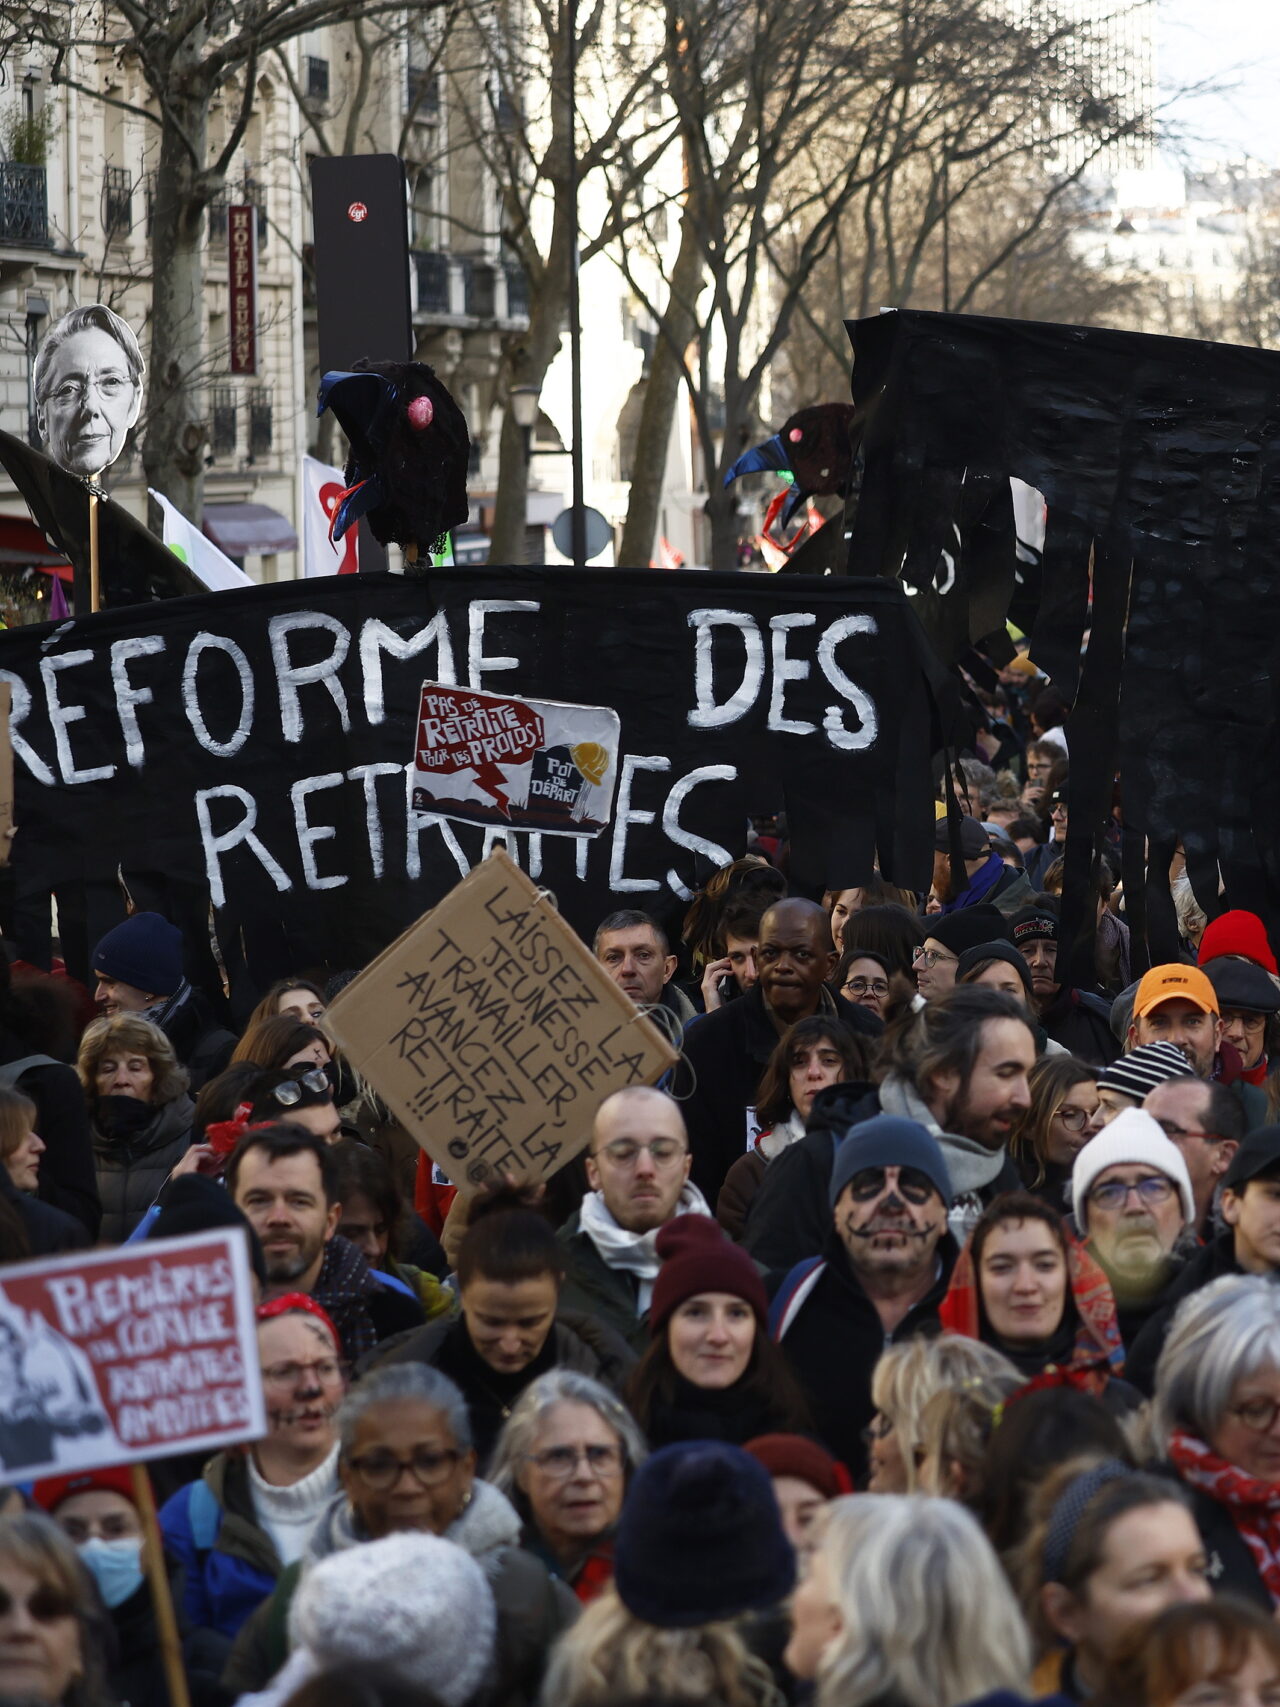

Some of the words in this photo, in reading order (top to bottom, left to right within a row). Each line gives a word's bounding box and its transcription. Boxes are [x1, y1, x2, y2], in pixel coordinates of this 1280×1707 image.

[232, 213, 249, 289] HOTEL
[0, 600, 541, 786] RÉFORME
[688, 608, 877, 749] DES
[424, 694, 457, 717] PAS
[461, 698, 481, 712] DE
[420, 750, 450, 767] POUR
[451, 750, 471, 767] LES
[467, 717, 544, 765] PROLOS!
[532, 779, 578, 803] DÉPART
[547, 758, 576, 777] POT
[553, 776, 567, 786] DE
[482, 936, 609, 1091] JEUNESSE
[396, 971, 526, 1124] AVANCEZ
[521, 1123, 563, 1170] LA
[598, 1025, 646, 1083] LA
[405, 1087, 440, 1121] !!!
